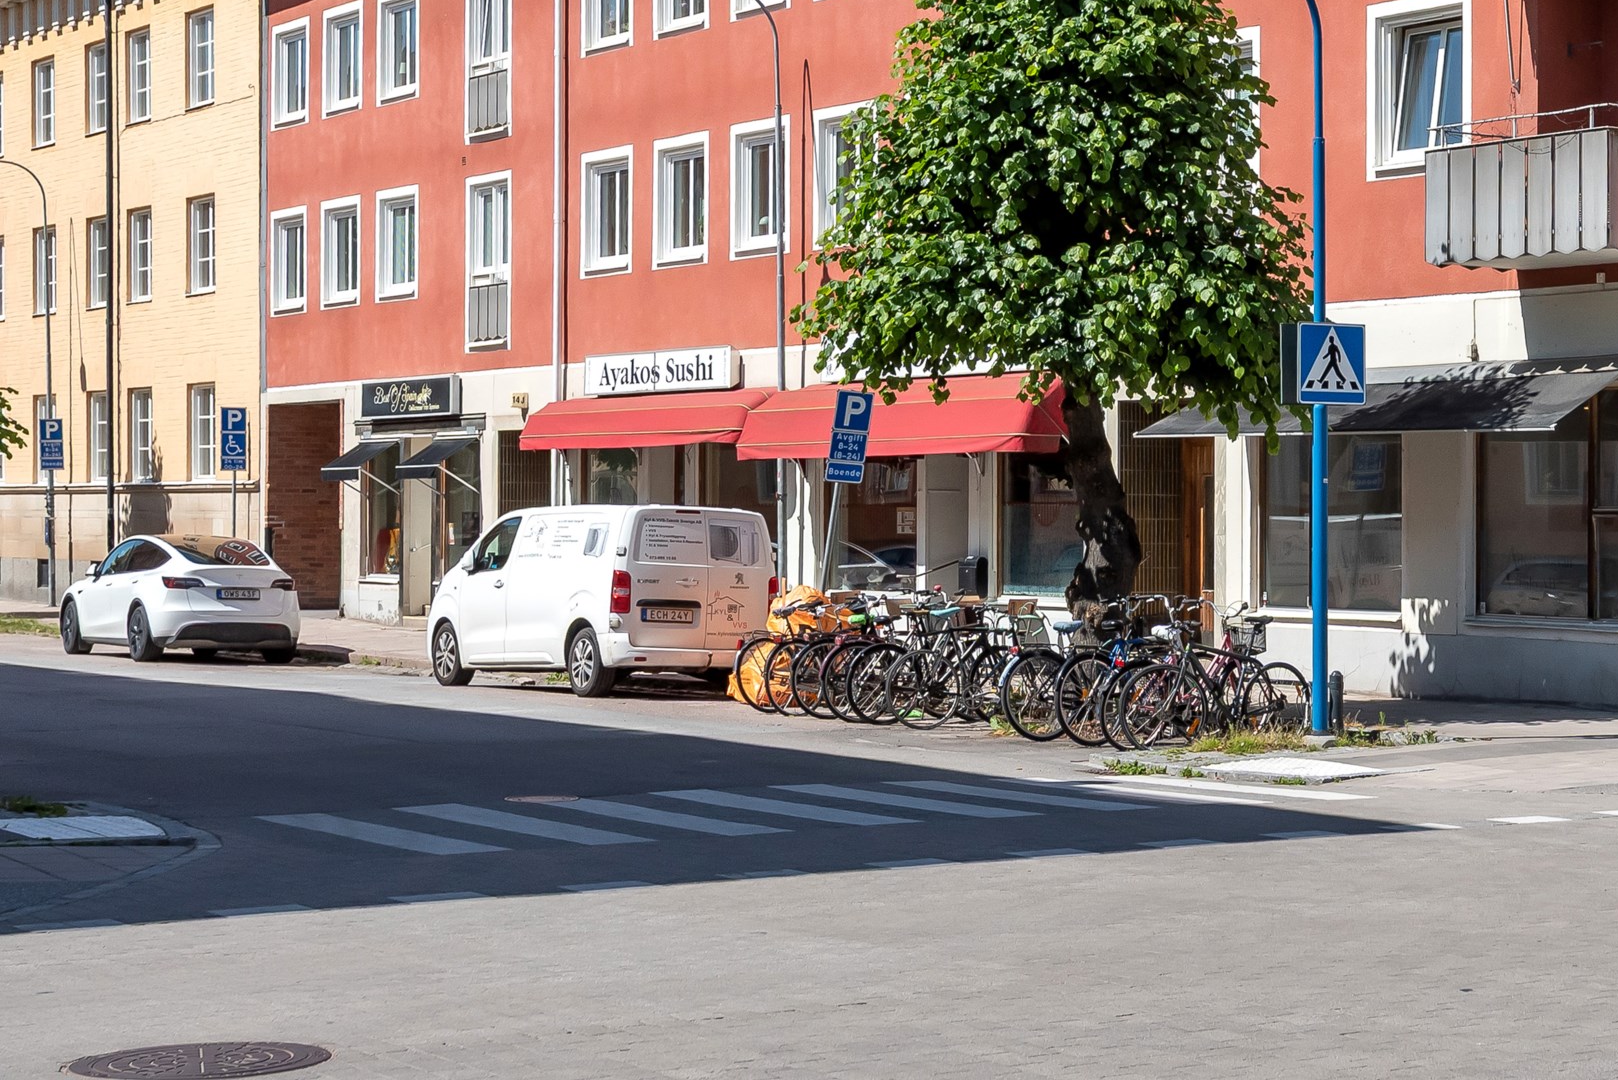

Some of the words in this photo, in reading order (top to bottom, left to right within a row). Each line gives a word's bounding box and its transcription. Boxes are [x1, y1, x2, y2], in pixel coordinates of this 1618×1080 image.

[599, 358, 661, 391] Ayakos
[665, 354, 714, 384] Sushi
[512, 395, 520, 404] 14
[843, 395, 867, 427] P
[227, 409, 242, 430] P
[45, 420, 59, 439] P
[836, 432, 864, 443] Avgift
[838, 442, 859, 451] 8-24
[834, 450, 861, 460] (8-24)
[828, 467, 861, 477] Boende
[650, 610, 668, 620] ECH
[671, 610, 689, 620] 24Y
